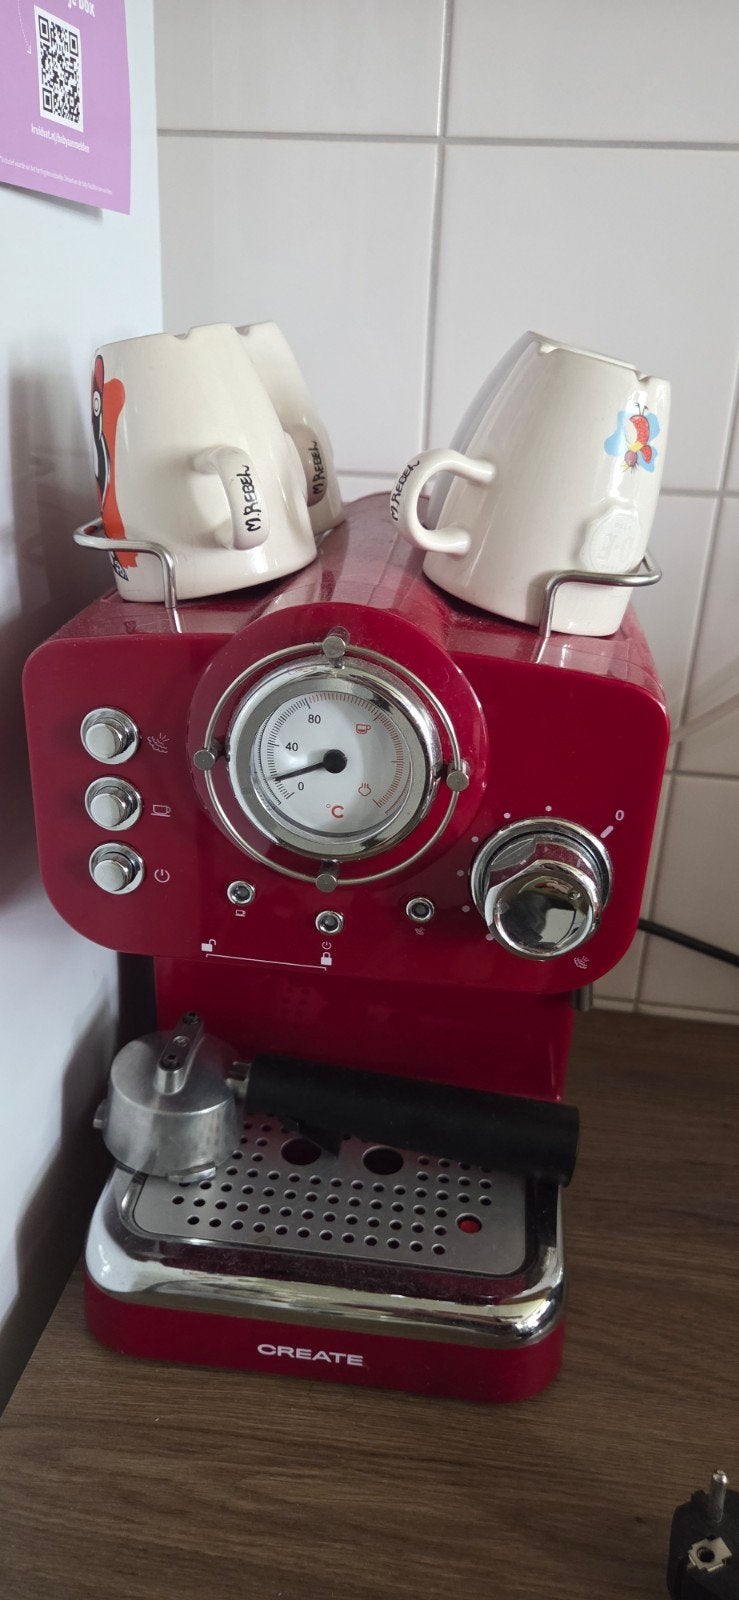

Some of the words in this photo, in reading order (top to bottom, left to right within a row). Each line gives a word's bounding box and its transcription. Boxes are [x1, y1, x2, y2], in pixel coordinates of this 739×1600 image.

[308, 714, 321, 724] 80
[285, 742, 299, 752] 40
[297, 781, 305, 791] 0
[615, 809, 625, 821] 0
[257, 1343, 363, 1367] CREATE
